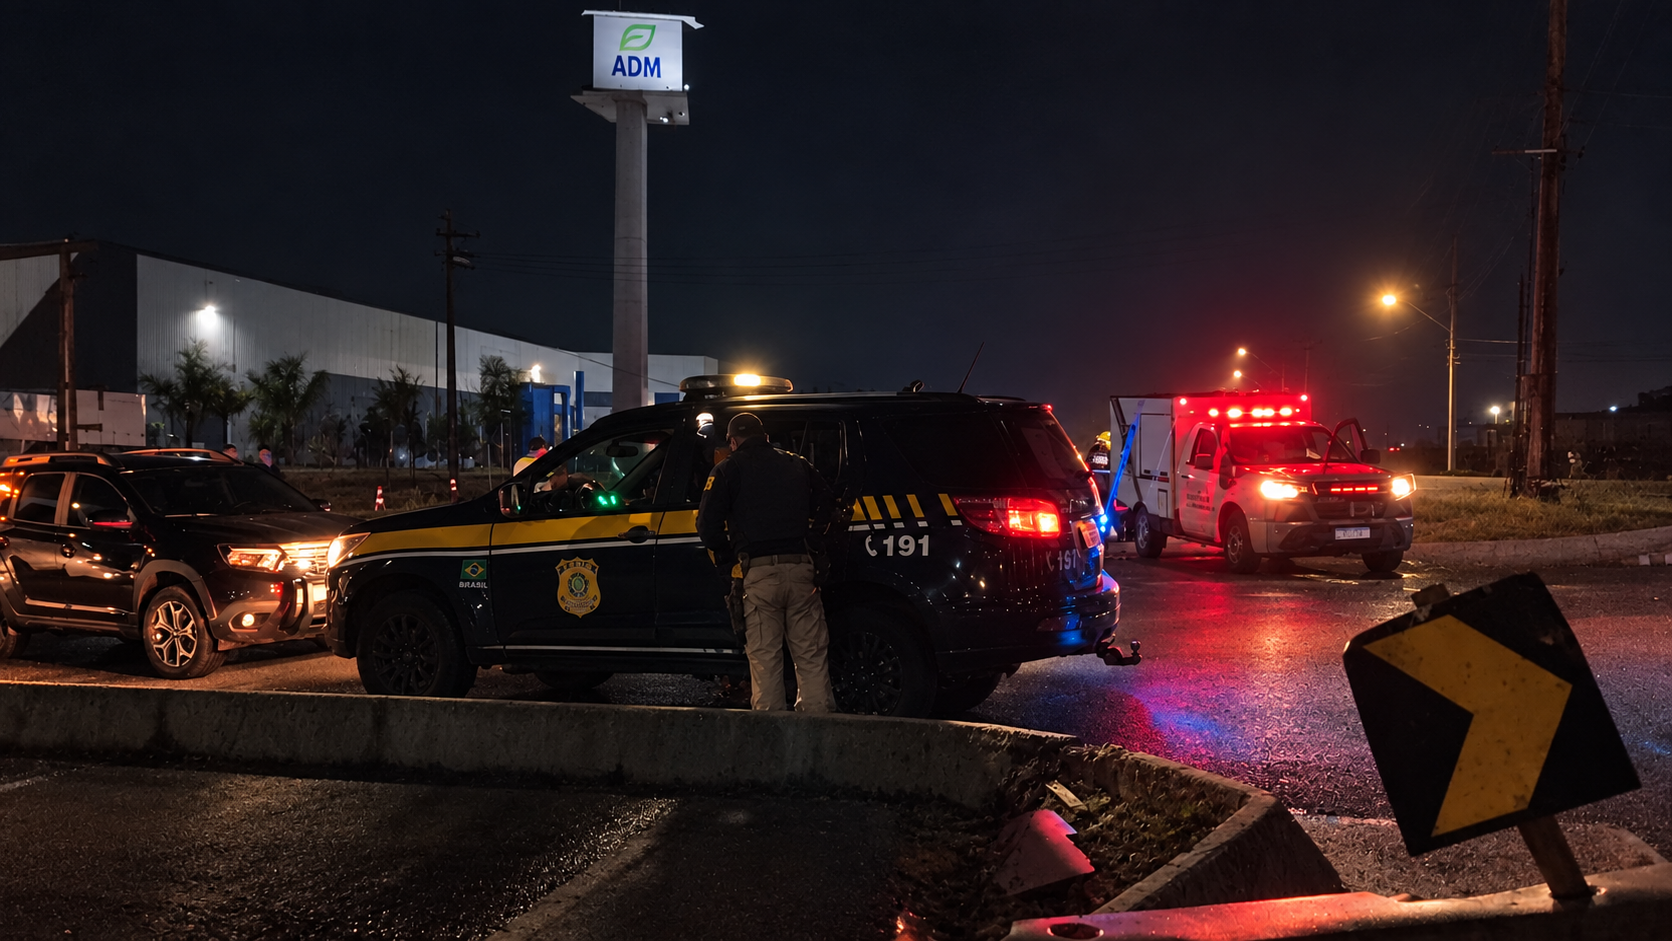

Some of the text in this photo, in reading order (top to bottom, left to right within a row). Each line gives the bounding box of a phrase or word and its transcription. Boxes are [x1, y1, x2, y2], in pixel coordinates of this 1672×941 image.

[611, 55, 661, 78] ADM
[883, 535, 929, 556] 191
[459, 581, 488, 589] BRASIL
